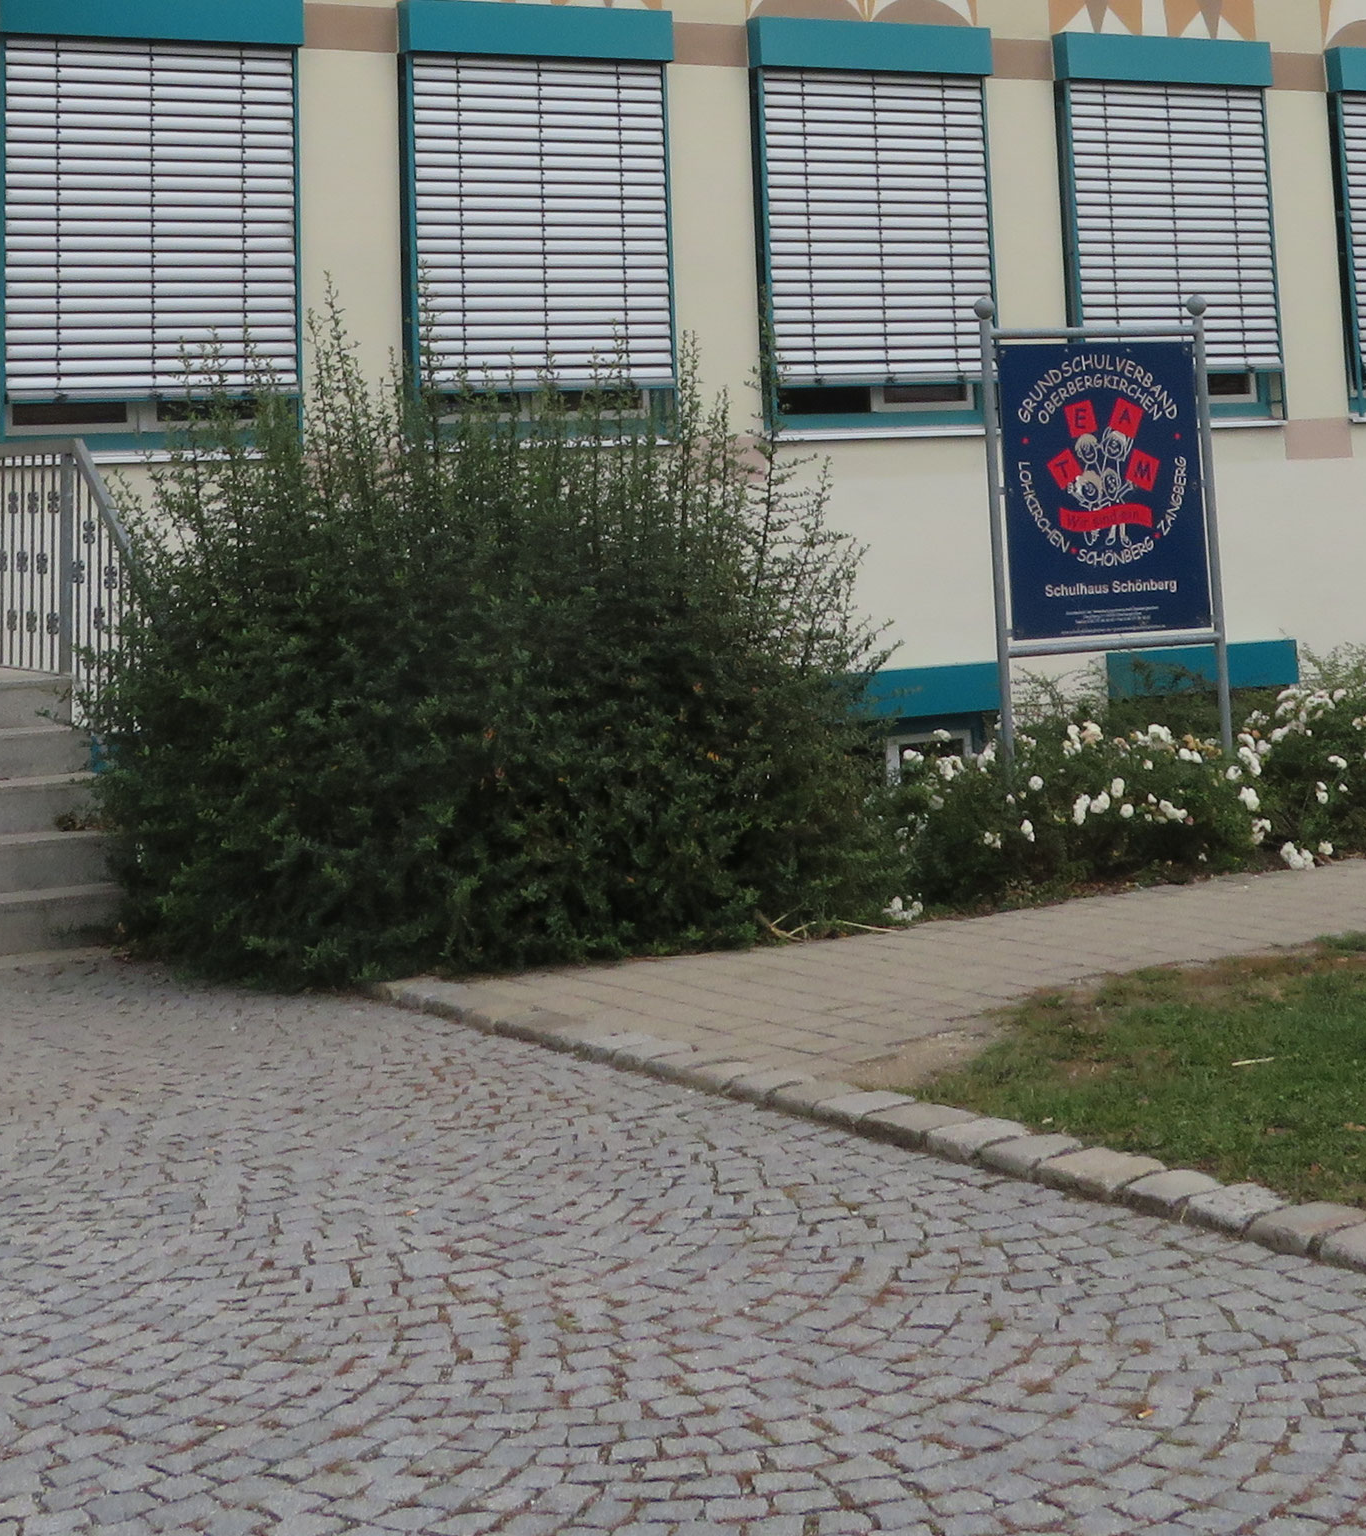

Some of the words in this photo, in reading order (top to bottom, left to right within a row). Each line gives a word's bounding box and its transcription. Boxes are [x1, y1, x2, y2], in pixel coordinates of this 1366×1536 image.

[1018, 354, 1178, 423] GRUNDSCHULVERBAND
[1037, 373, 1163, 425] OBERBERGKIRCHEN
[1018, 461, 1070, 553] LOHKIRCHEN
[1076, 536, 1155, 566] SCHÖNBERG
[1157, 455, 1187, 536] ZANGBERG
[1044, 583, 1110, 598] Schulhaus
[1111, 578, 1178, 594] Schönberg
